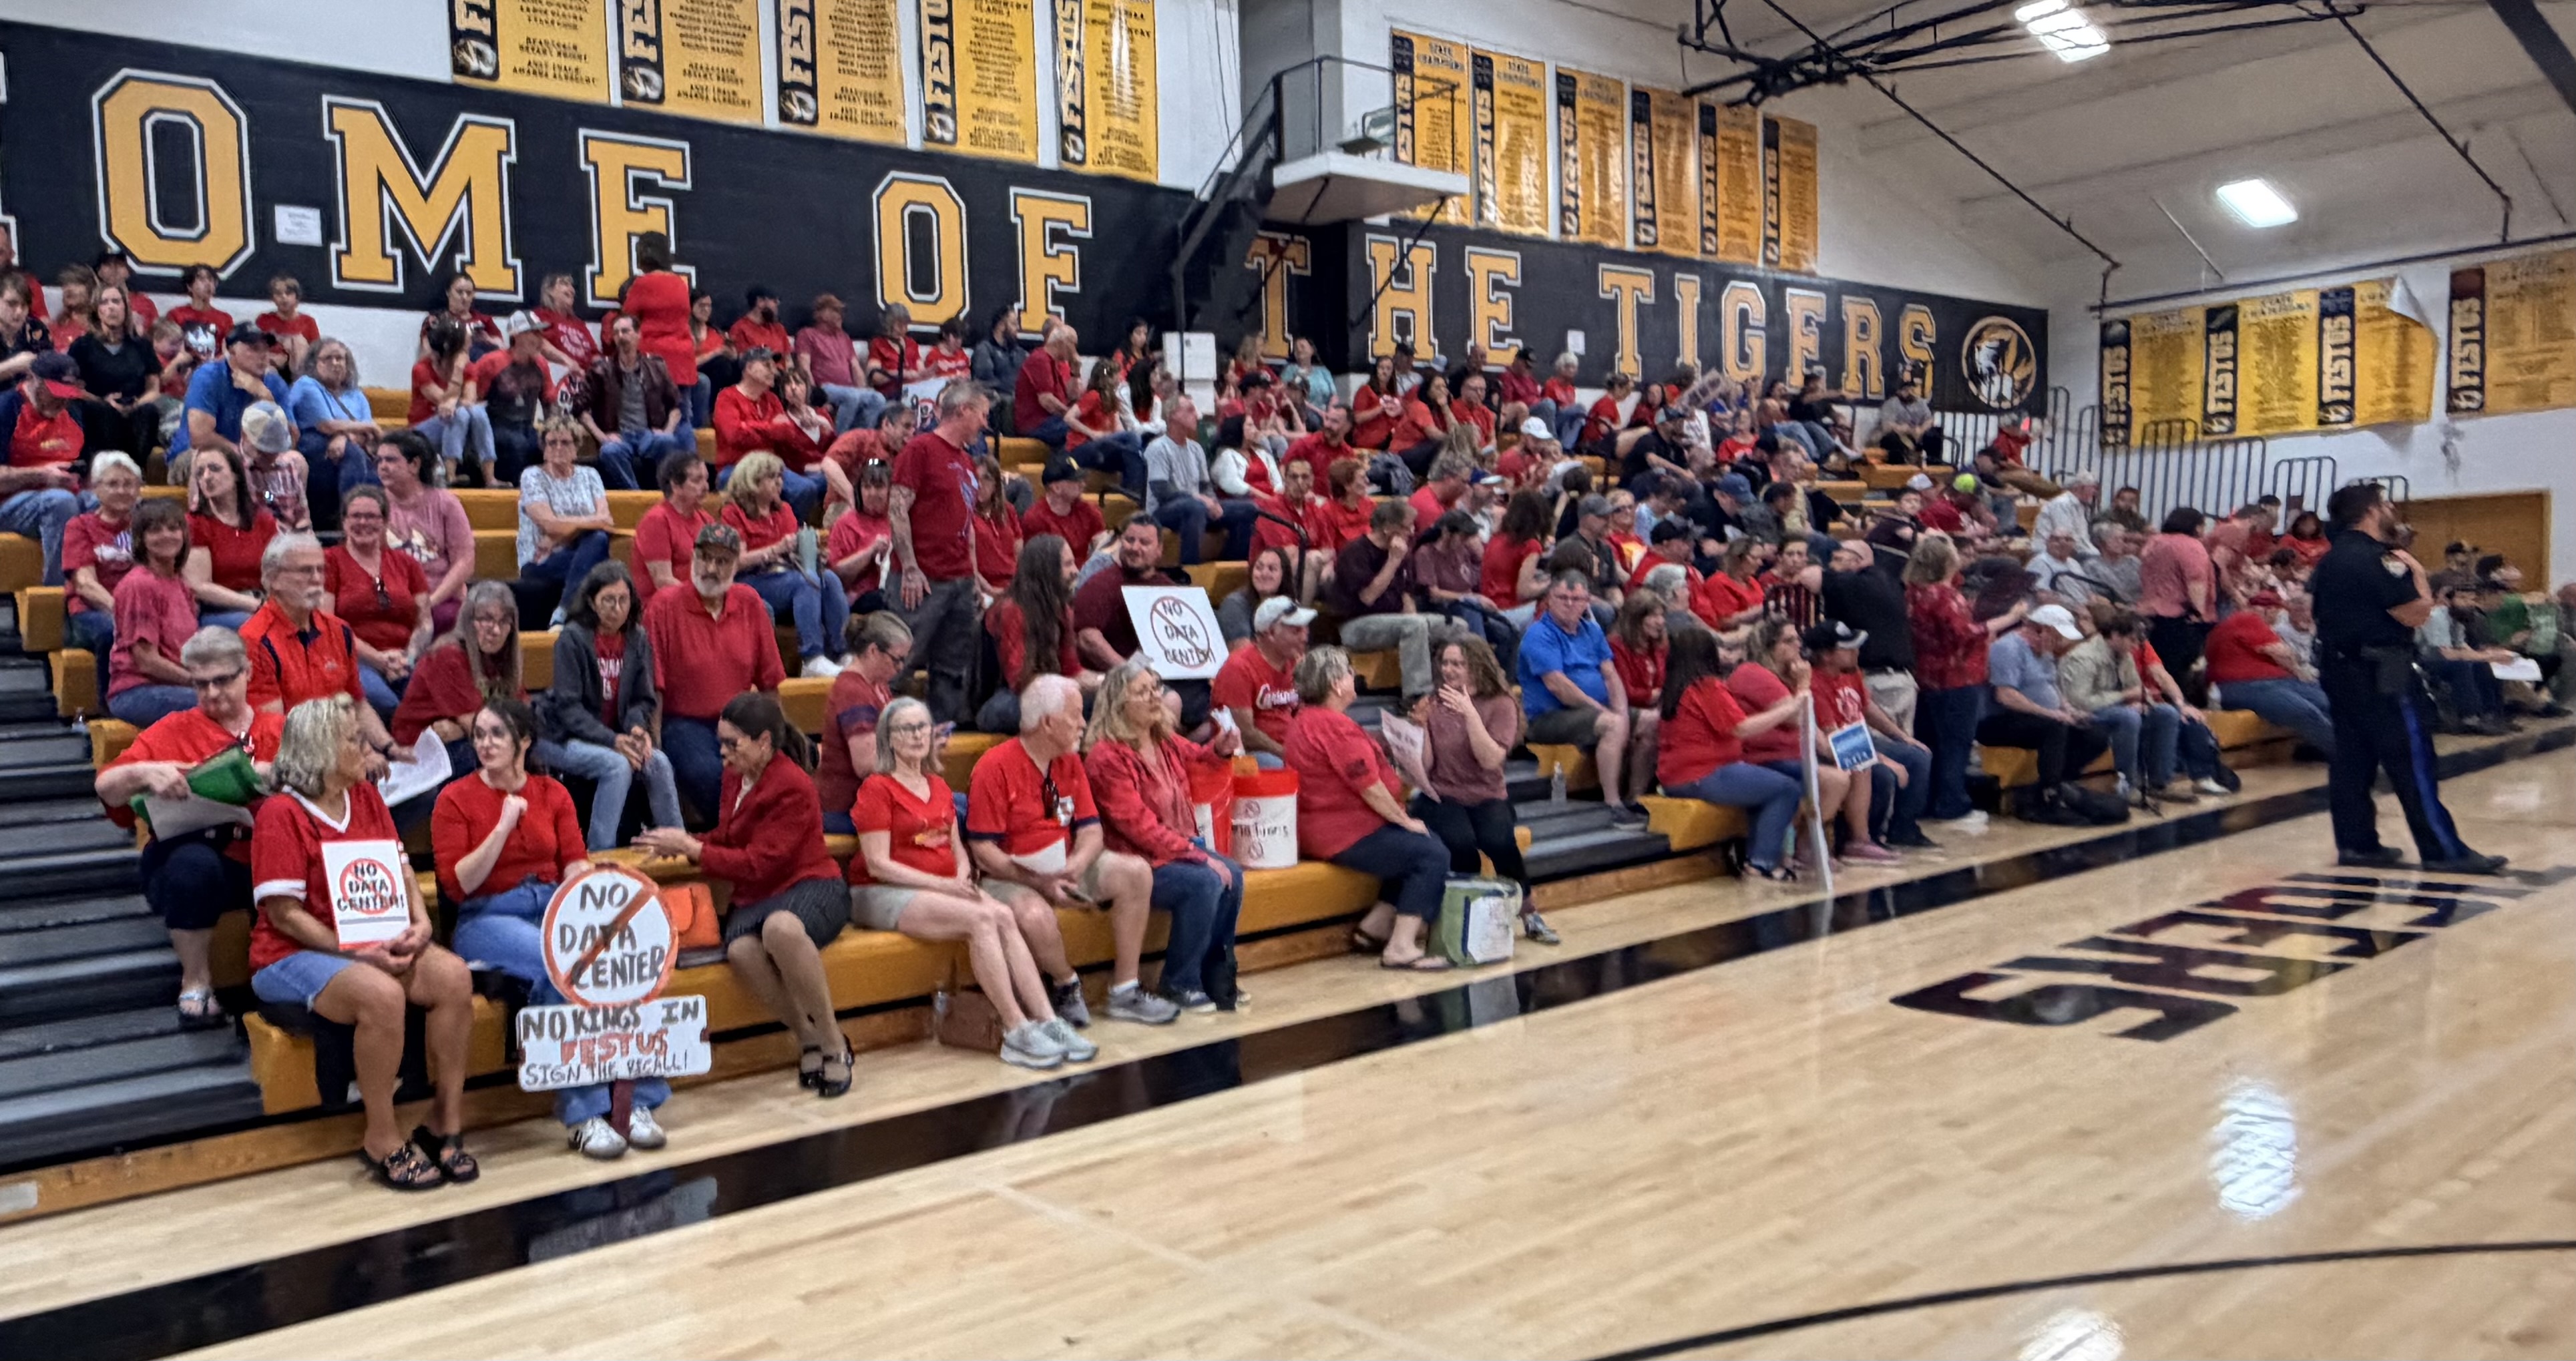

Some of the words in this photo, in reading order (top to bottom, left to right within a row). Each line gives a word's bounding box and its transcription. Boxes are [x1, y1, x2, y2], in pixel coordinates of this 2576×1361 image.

[0, 51, 696, 308] OME
[872, 170, 1093, 341] OF
[1245, 230, 1524, 373] THE
[1598, 262, 1936, 402] TIGERS
[1162, 601, 1183, 617] NO
[1164, 623, 1199, 641] DATA
[353, 862, 378, 878] NO
[348, 878, 389, 894] DATA
[579, 882, 629, 911] NO
[559, 923, 637, 954] DATA
[570, 944, 666, 990] CENTER
[522, 1009, 567, 1041] NO
[572, 1001, 642, 1033] KINGS
[661, 999, 699, 1024] IN
[560, 1029, 669, 1066] FESTUS
[525, 1062, 581, 1086] SIGN
[586, 1060, 618, 1082] THE
